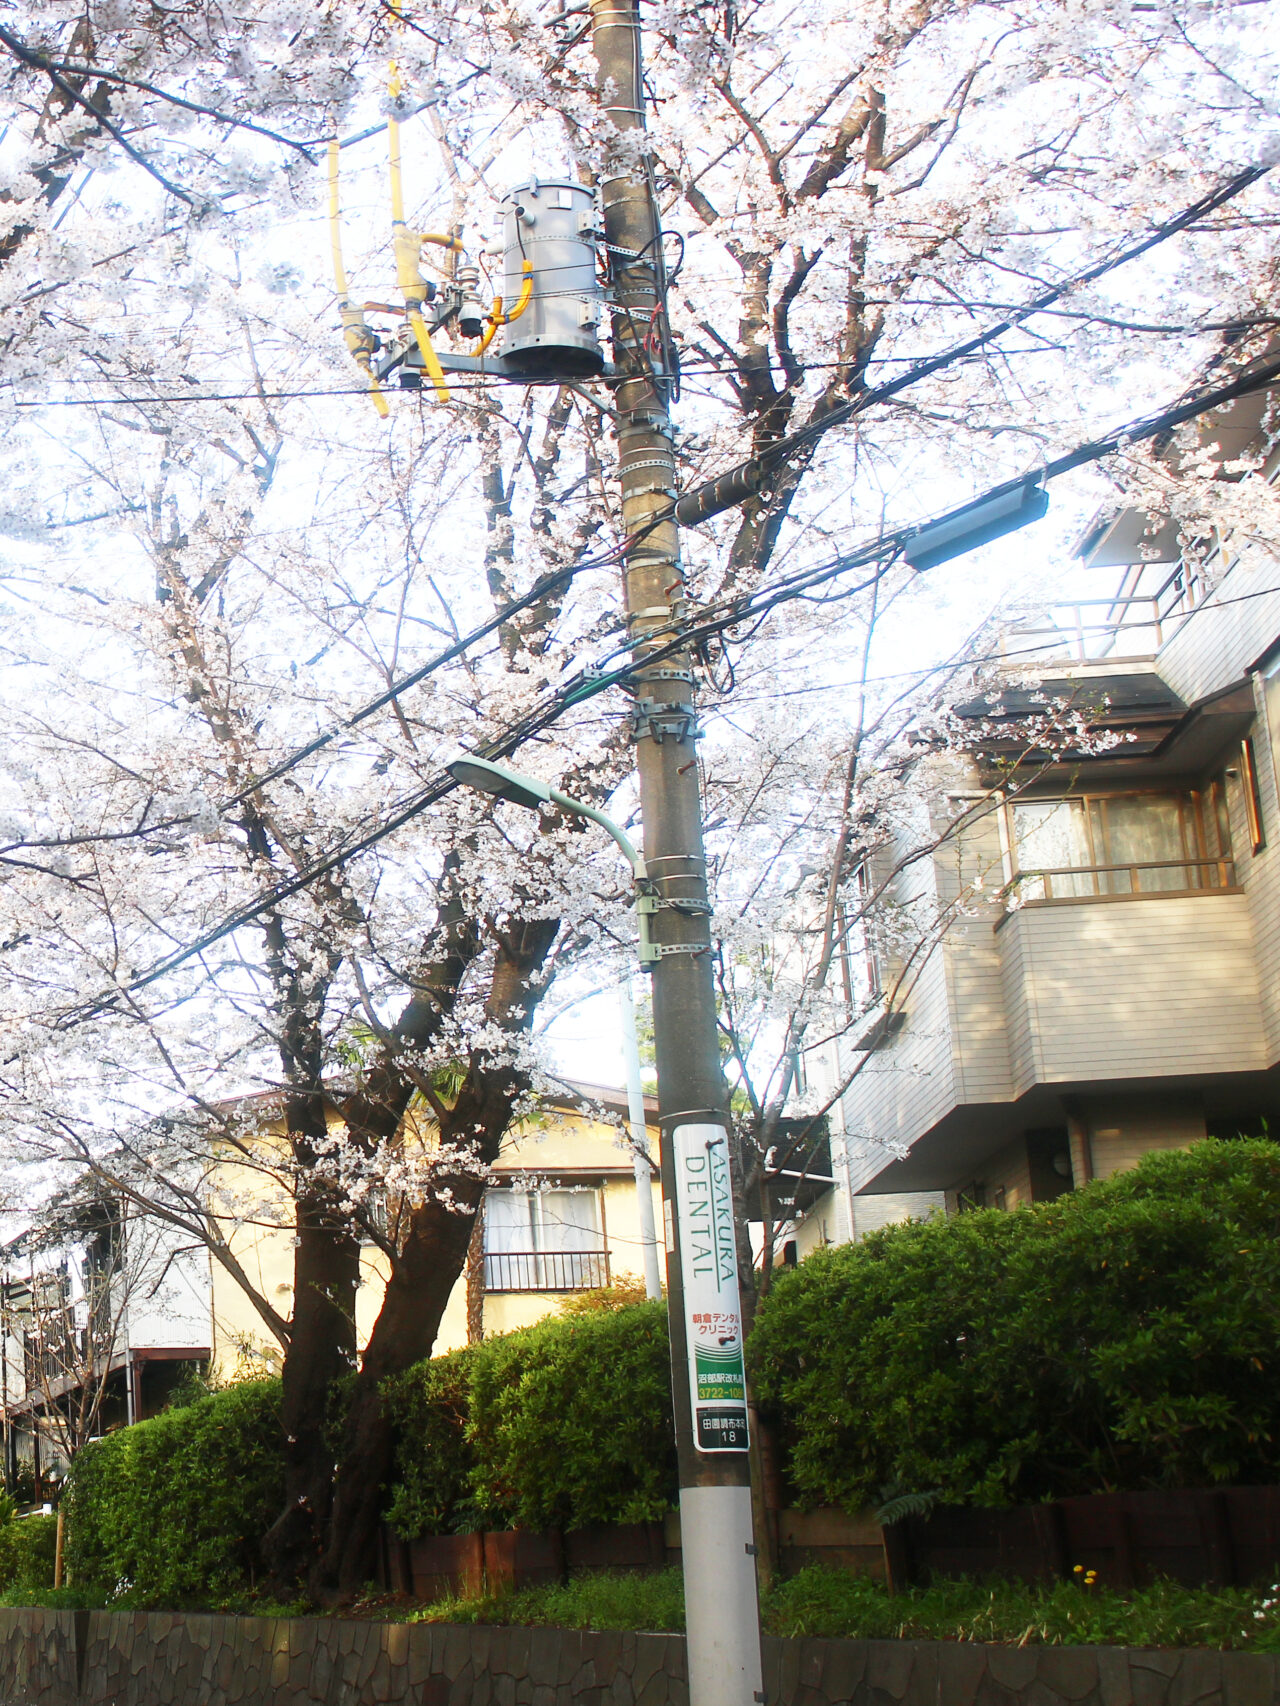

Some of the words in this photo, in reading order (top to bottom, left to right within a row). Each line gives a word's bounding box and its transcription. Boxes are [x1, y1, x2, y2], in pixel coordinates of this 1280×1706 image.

[685, 1156, 713, 1278] DENTAL
[713, 1152, 734, 1281] ASAKURA
[692, 1313, 739, 1324] 朝倉デンタル
[699, 1325, 738, 1335] クリニック
[722, 1431, 736, 1442] 18
